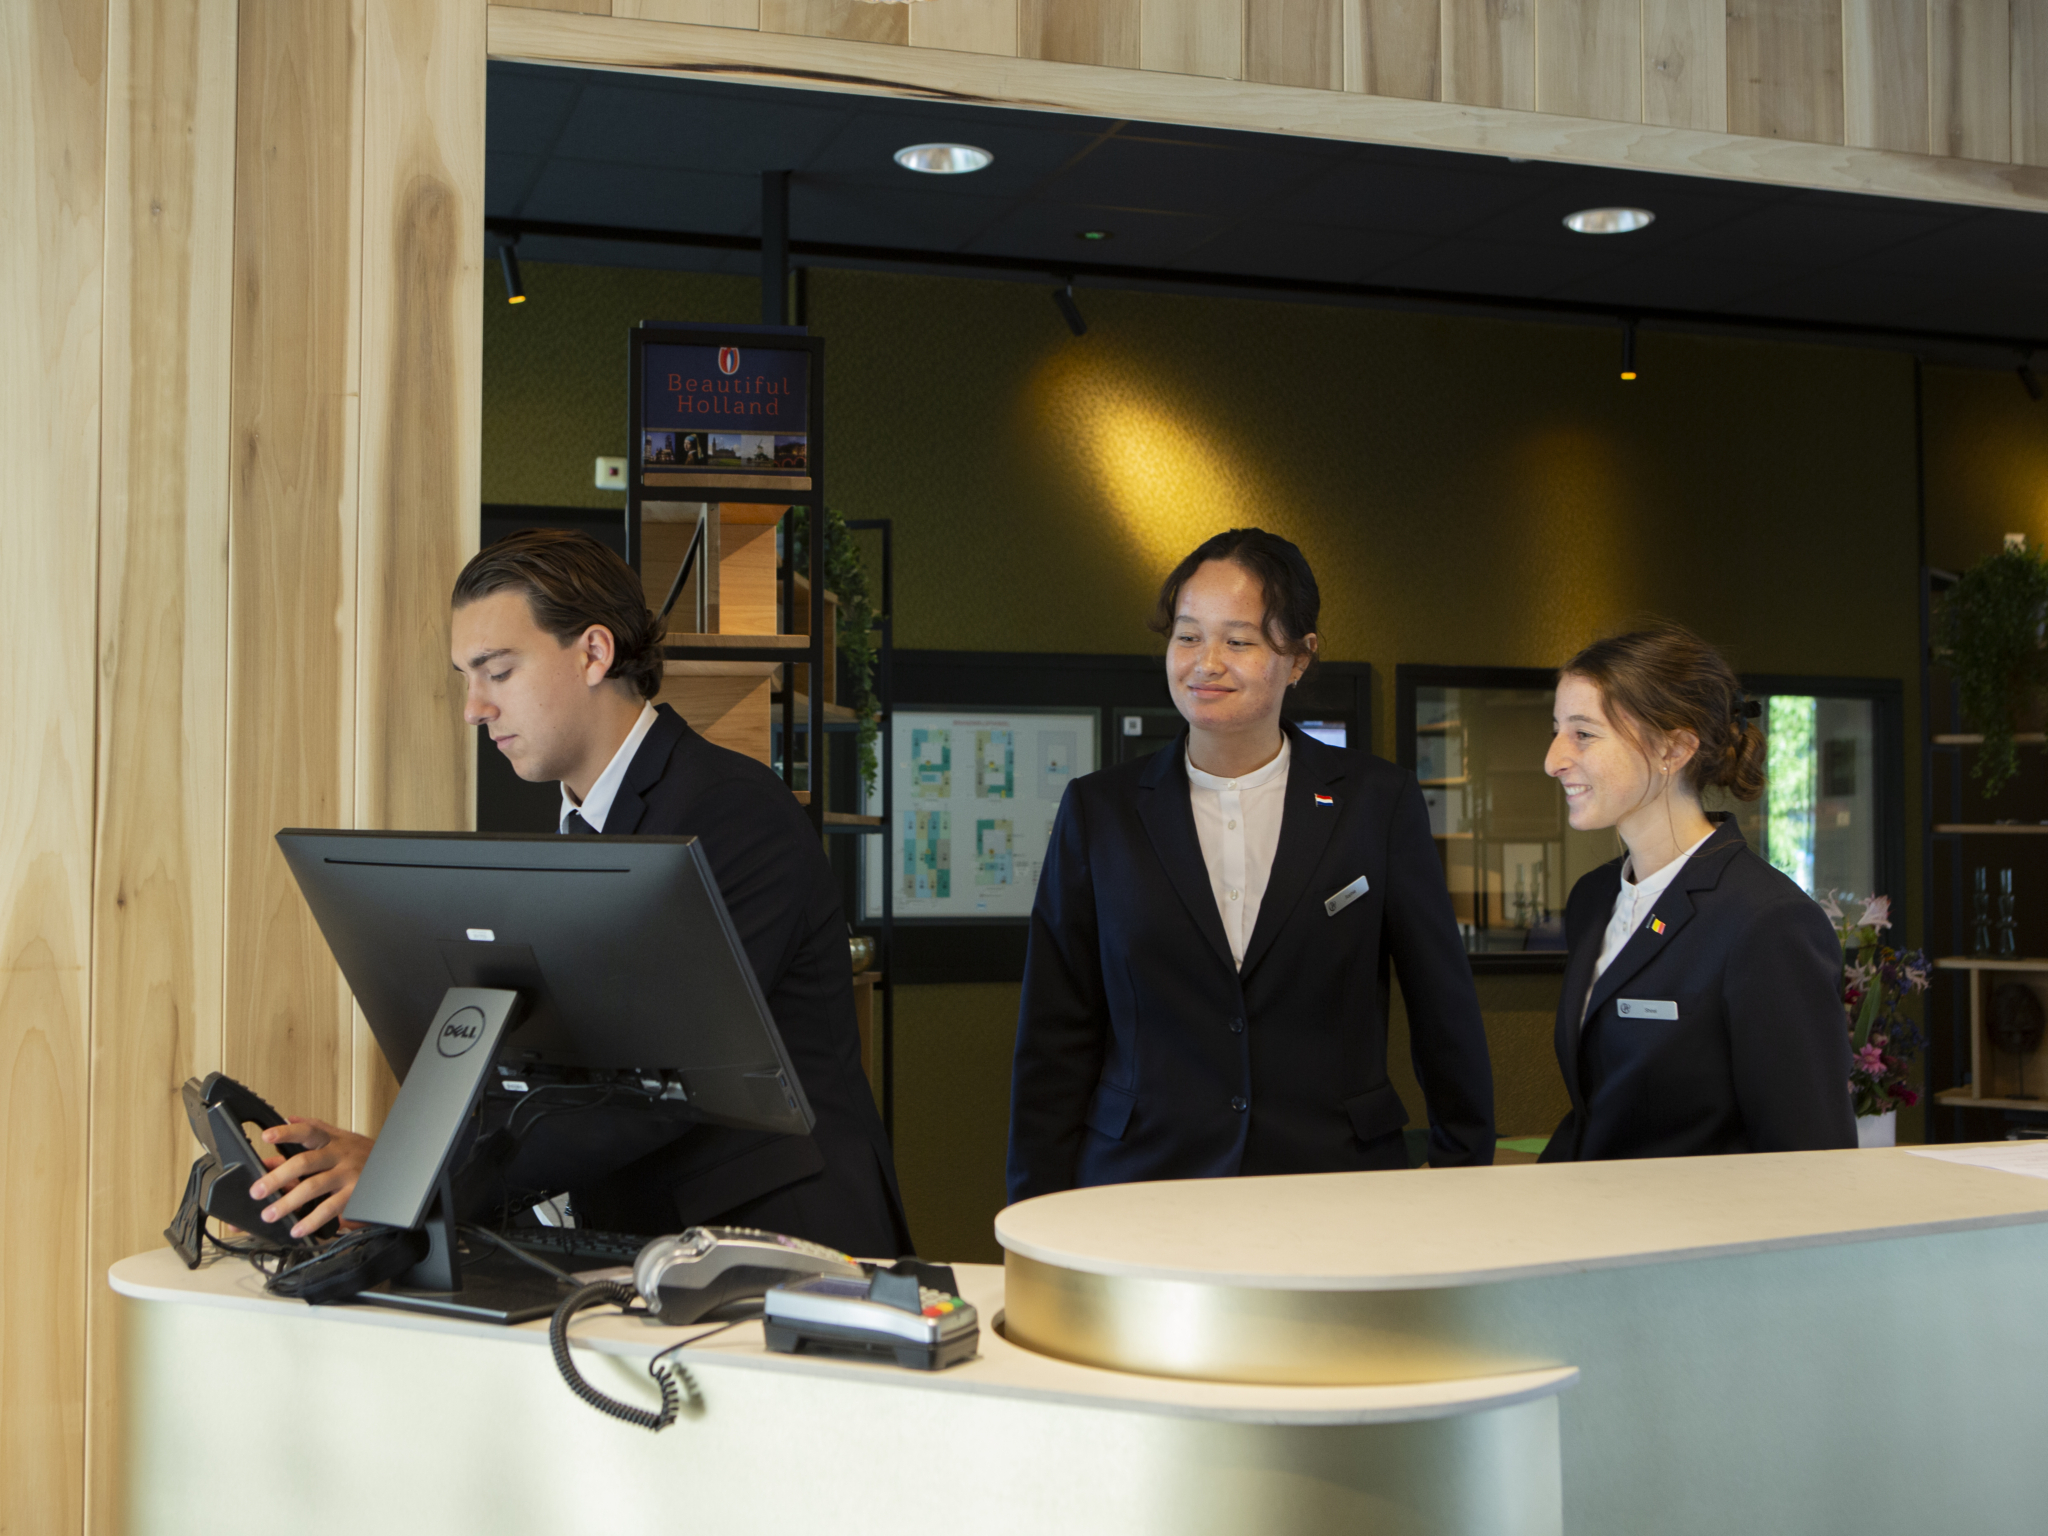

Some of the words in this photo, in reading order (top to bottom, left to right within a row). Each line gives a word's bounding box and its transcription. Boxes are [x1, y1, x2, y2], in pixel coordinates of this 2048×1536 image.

[668, 373, 790, 395] Beautiful
[677, 395, 779, 415] Holland
[444, 1025, 476, 1038] DELL
